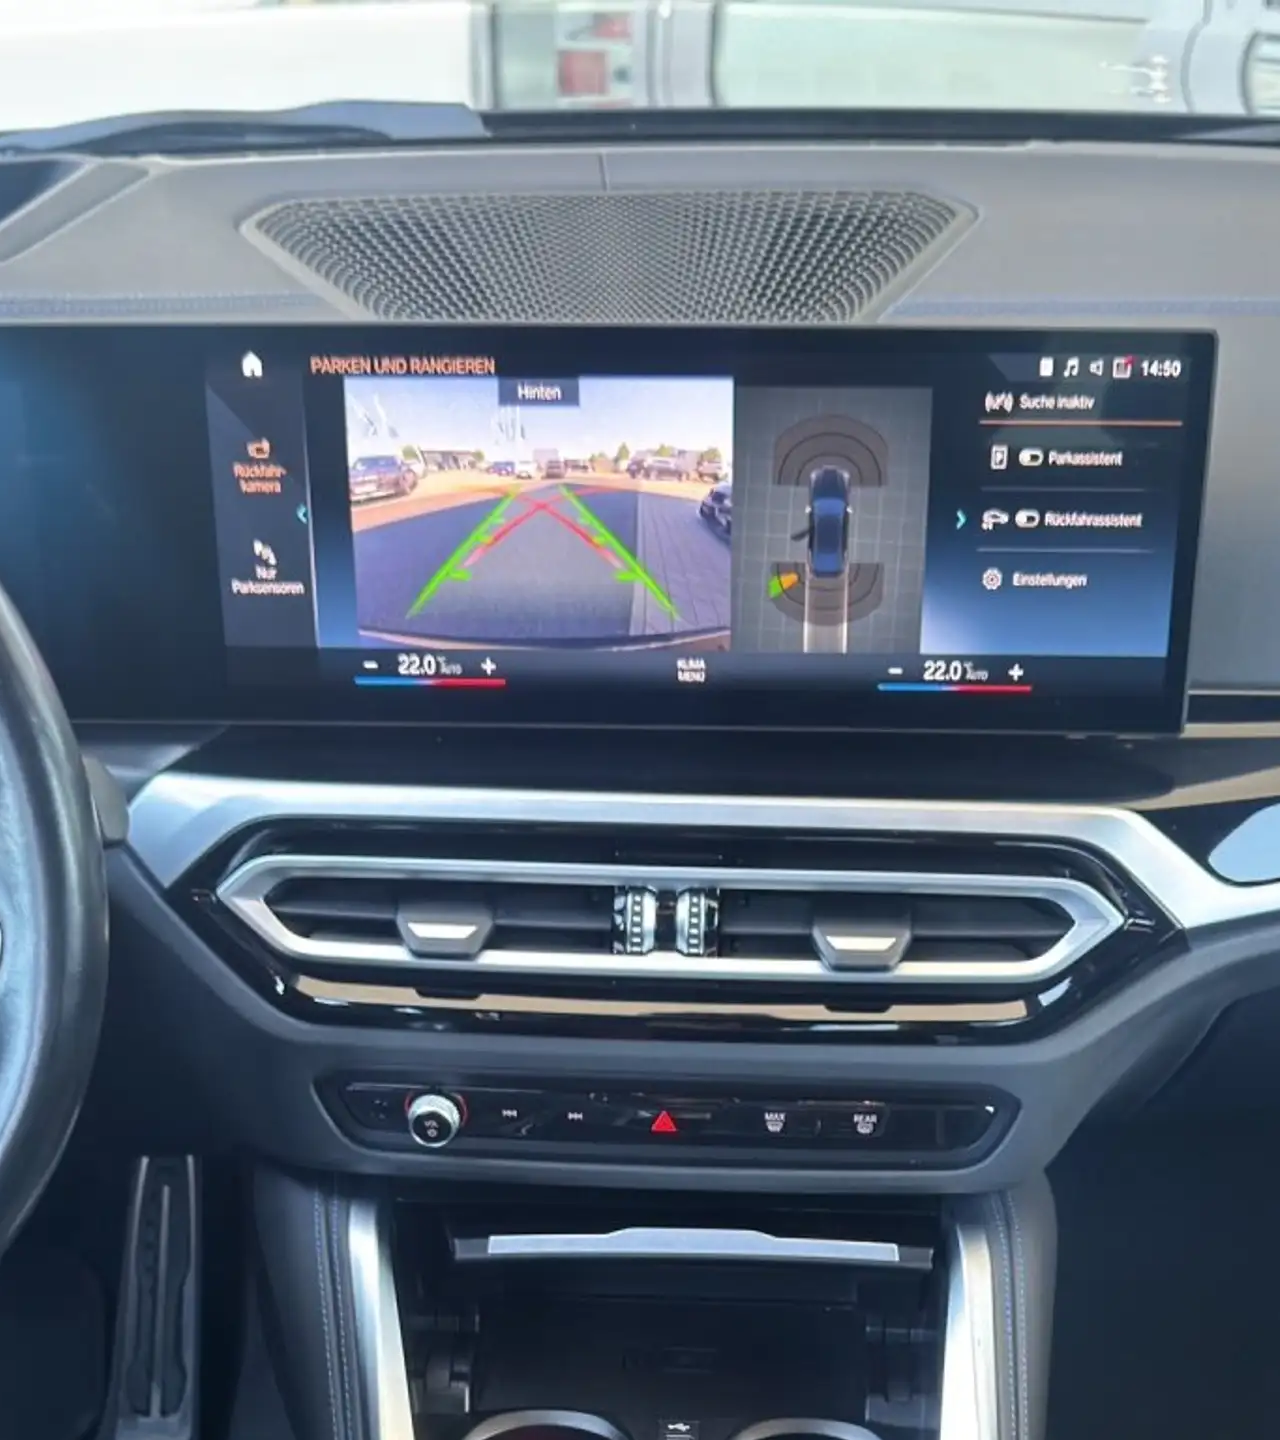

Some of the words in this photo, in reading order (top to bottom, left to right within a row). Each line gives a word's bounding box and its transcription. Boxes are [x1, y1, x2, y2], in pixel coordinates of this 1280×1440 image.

[310, 356, 370, 374] PARKEN
[374, 357, 407, 374] UND
[410, 357, 495, 374] RANGIEREN
[1141, 360, 1182, 377] 14:50
[517, 383, 562, 400] Hinten
[1020, 394, 1055, 410] Suche
[1057, 395, 1095, 411] inaktiv
[1048, 451, 1122, 467] Parkassistent
[1044, 510, 1143, 528] Rückfahrassistent
[231, 577, 304, 595] Parksensoren
[1012, 571, 1088, 589] Einstellungen
[398, 652, 436, 676] 22.0
[923, 660, 962, 681] 22.0
